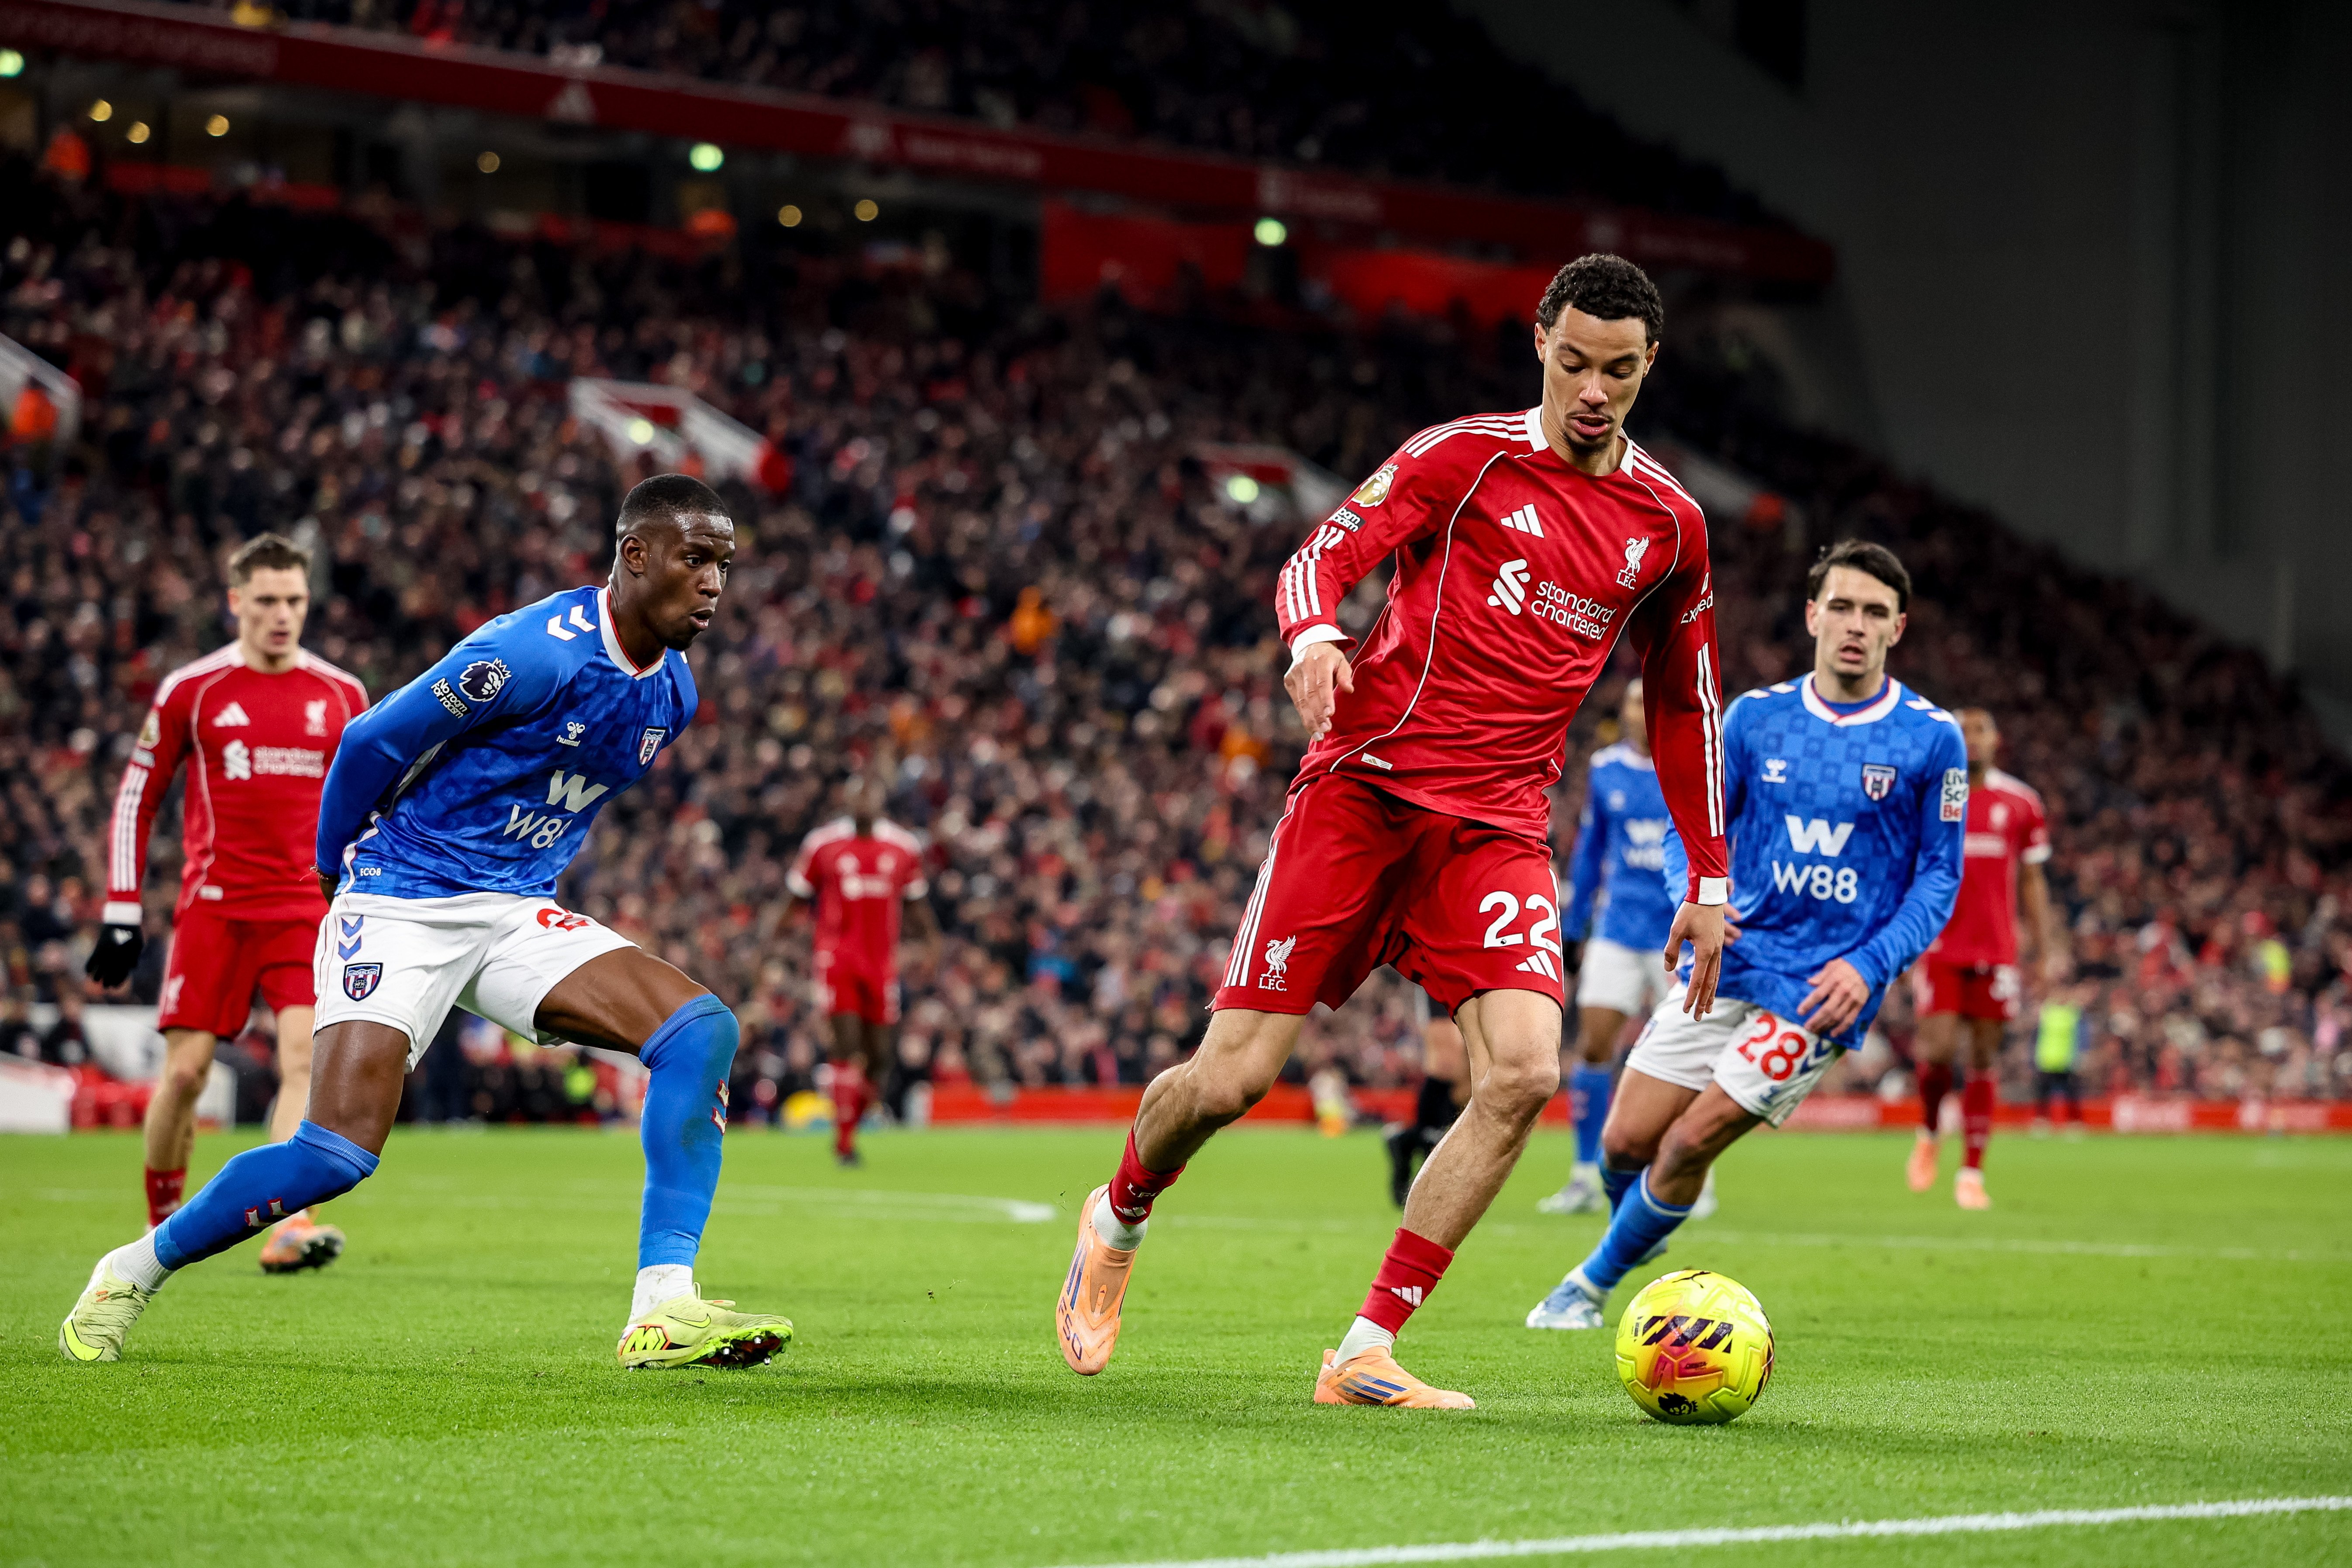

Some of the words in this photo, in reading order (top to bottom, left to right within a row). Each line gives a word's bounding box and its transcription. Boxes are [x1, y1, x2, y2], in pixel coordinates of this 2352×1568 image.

[1531, 600, 1609, 640] chartered
[1536, 581, 1617, 623] standard
[437, 678, 450, 693] No
[446, 693, 467, 712] room
[439, 696, 463, 719] racism
[556, 735, 580, 747] hummel
[1772, 859, 1858, 904] W88
[1479, 890, 1561, 959] 22
[1258, 977, 1287, 991] L.F.C.
[1737, 1013, 1807, 1081] 28
